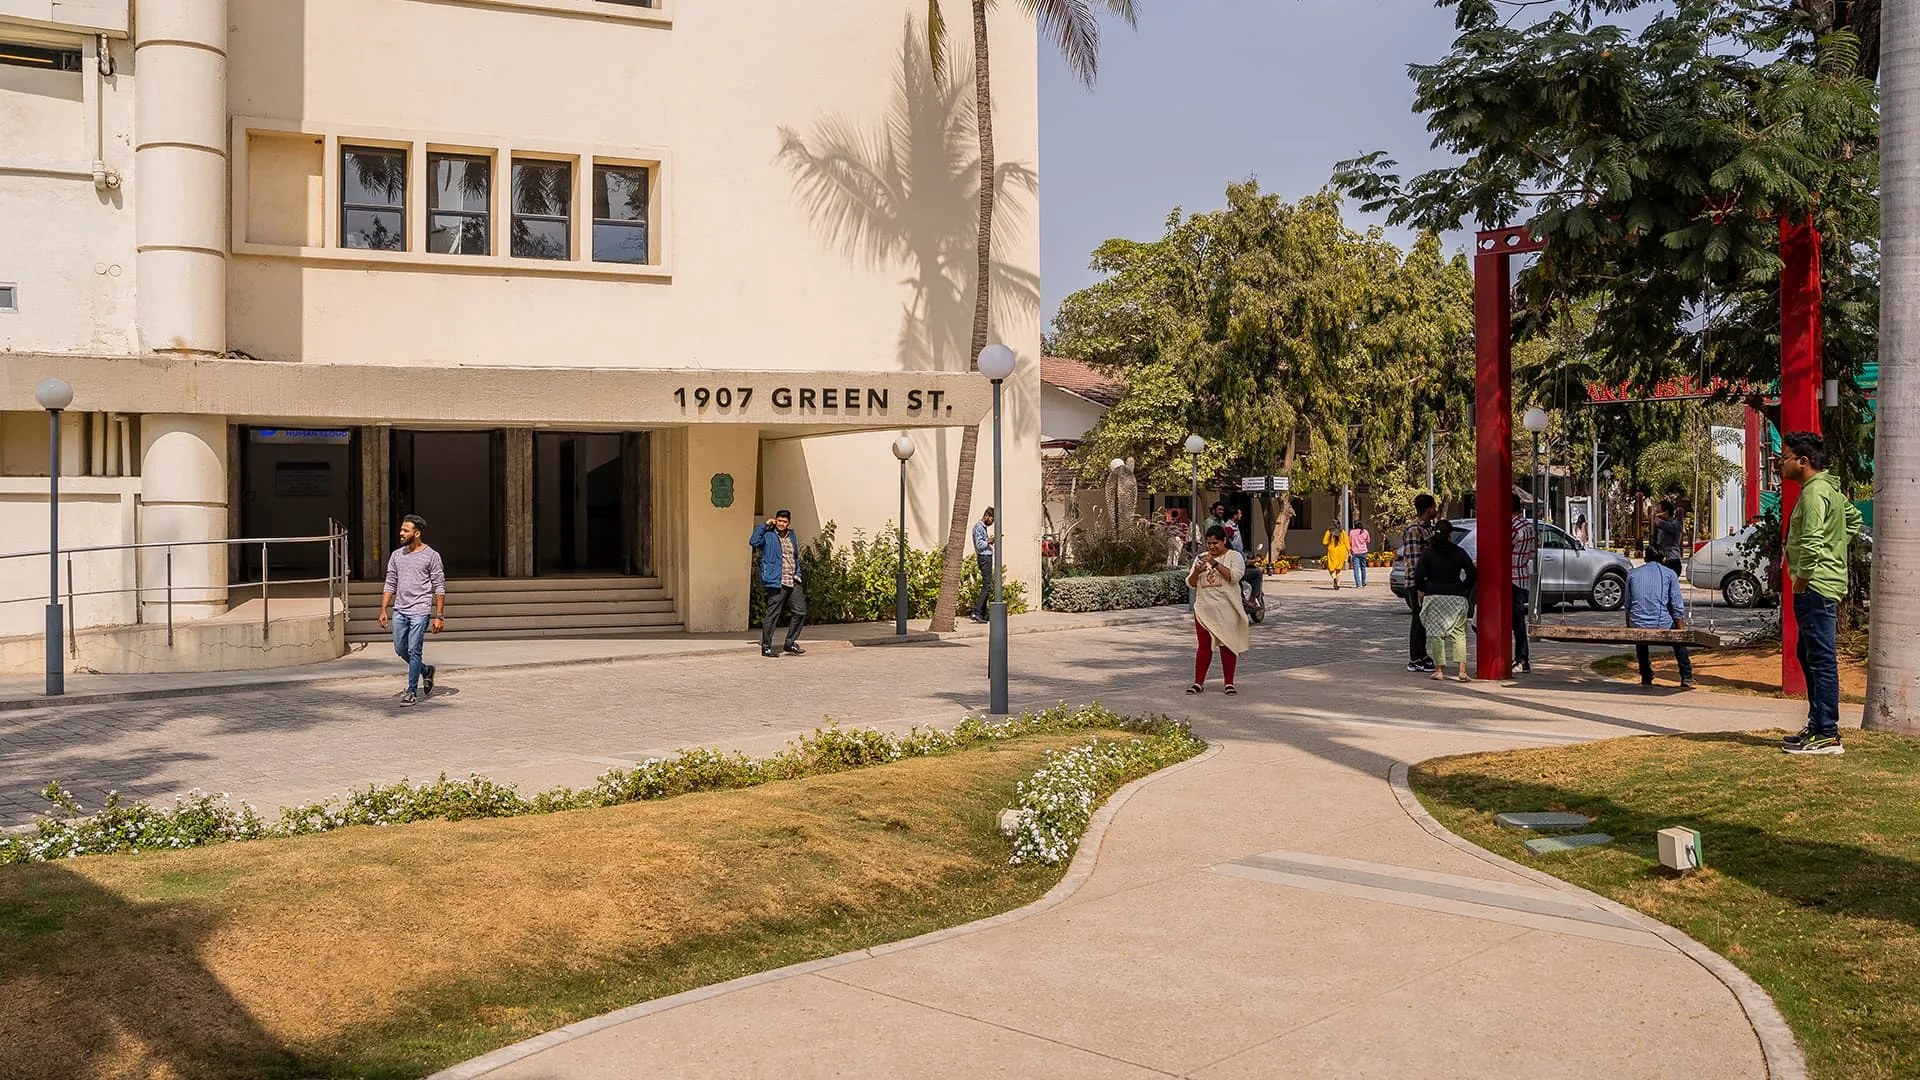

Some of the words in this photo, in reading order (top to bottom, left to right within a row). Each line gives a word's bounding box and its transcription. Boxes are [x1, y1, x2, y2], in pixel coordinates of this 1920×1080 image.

[673, 387, 753, 409] 1907
[771, 387, 889, 409] GREEN
[907, 389, 953, 411] ST.
